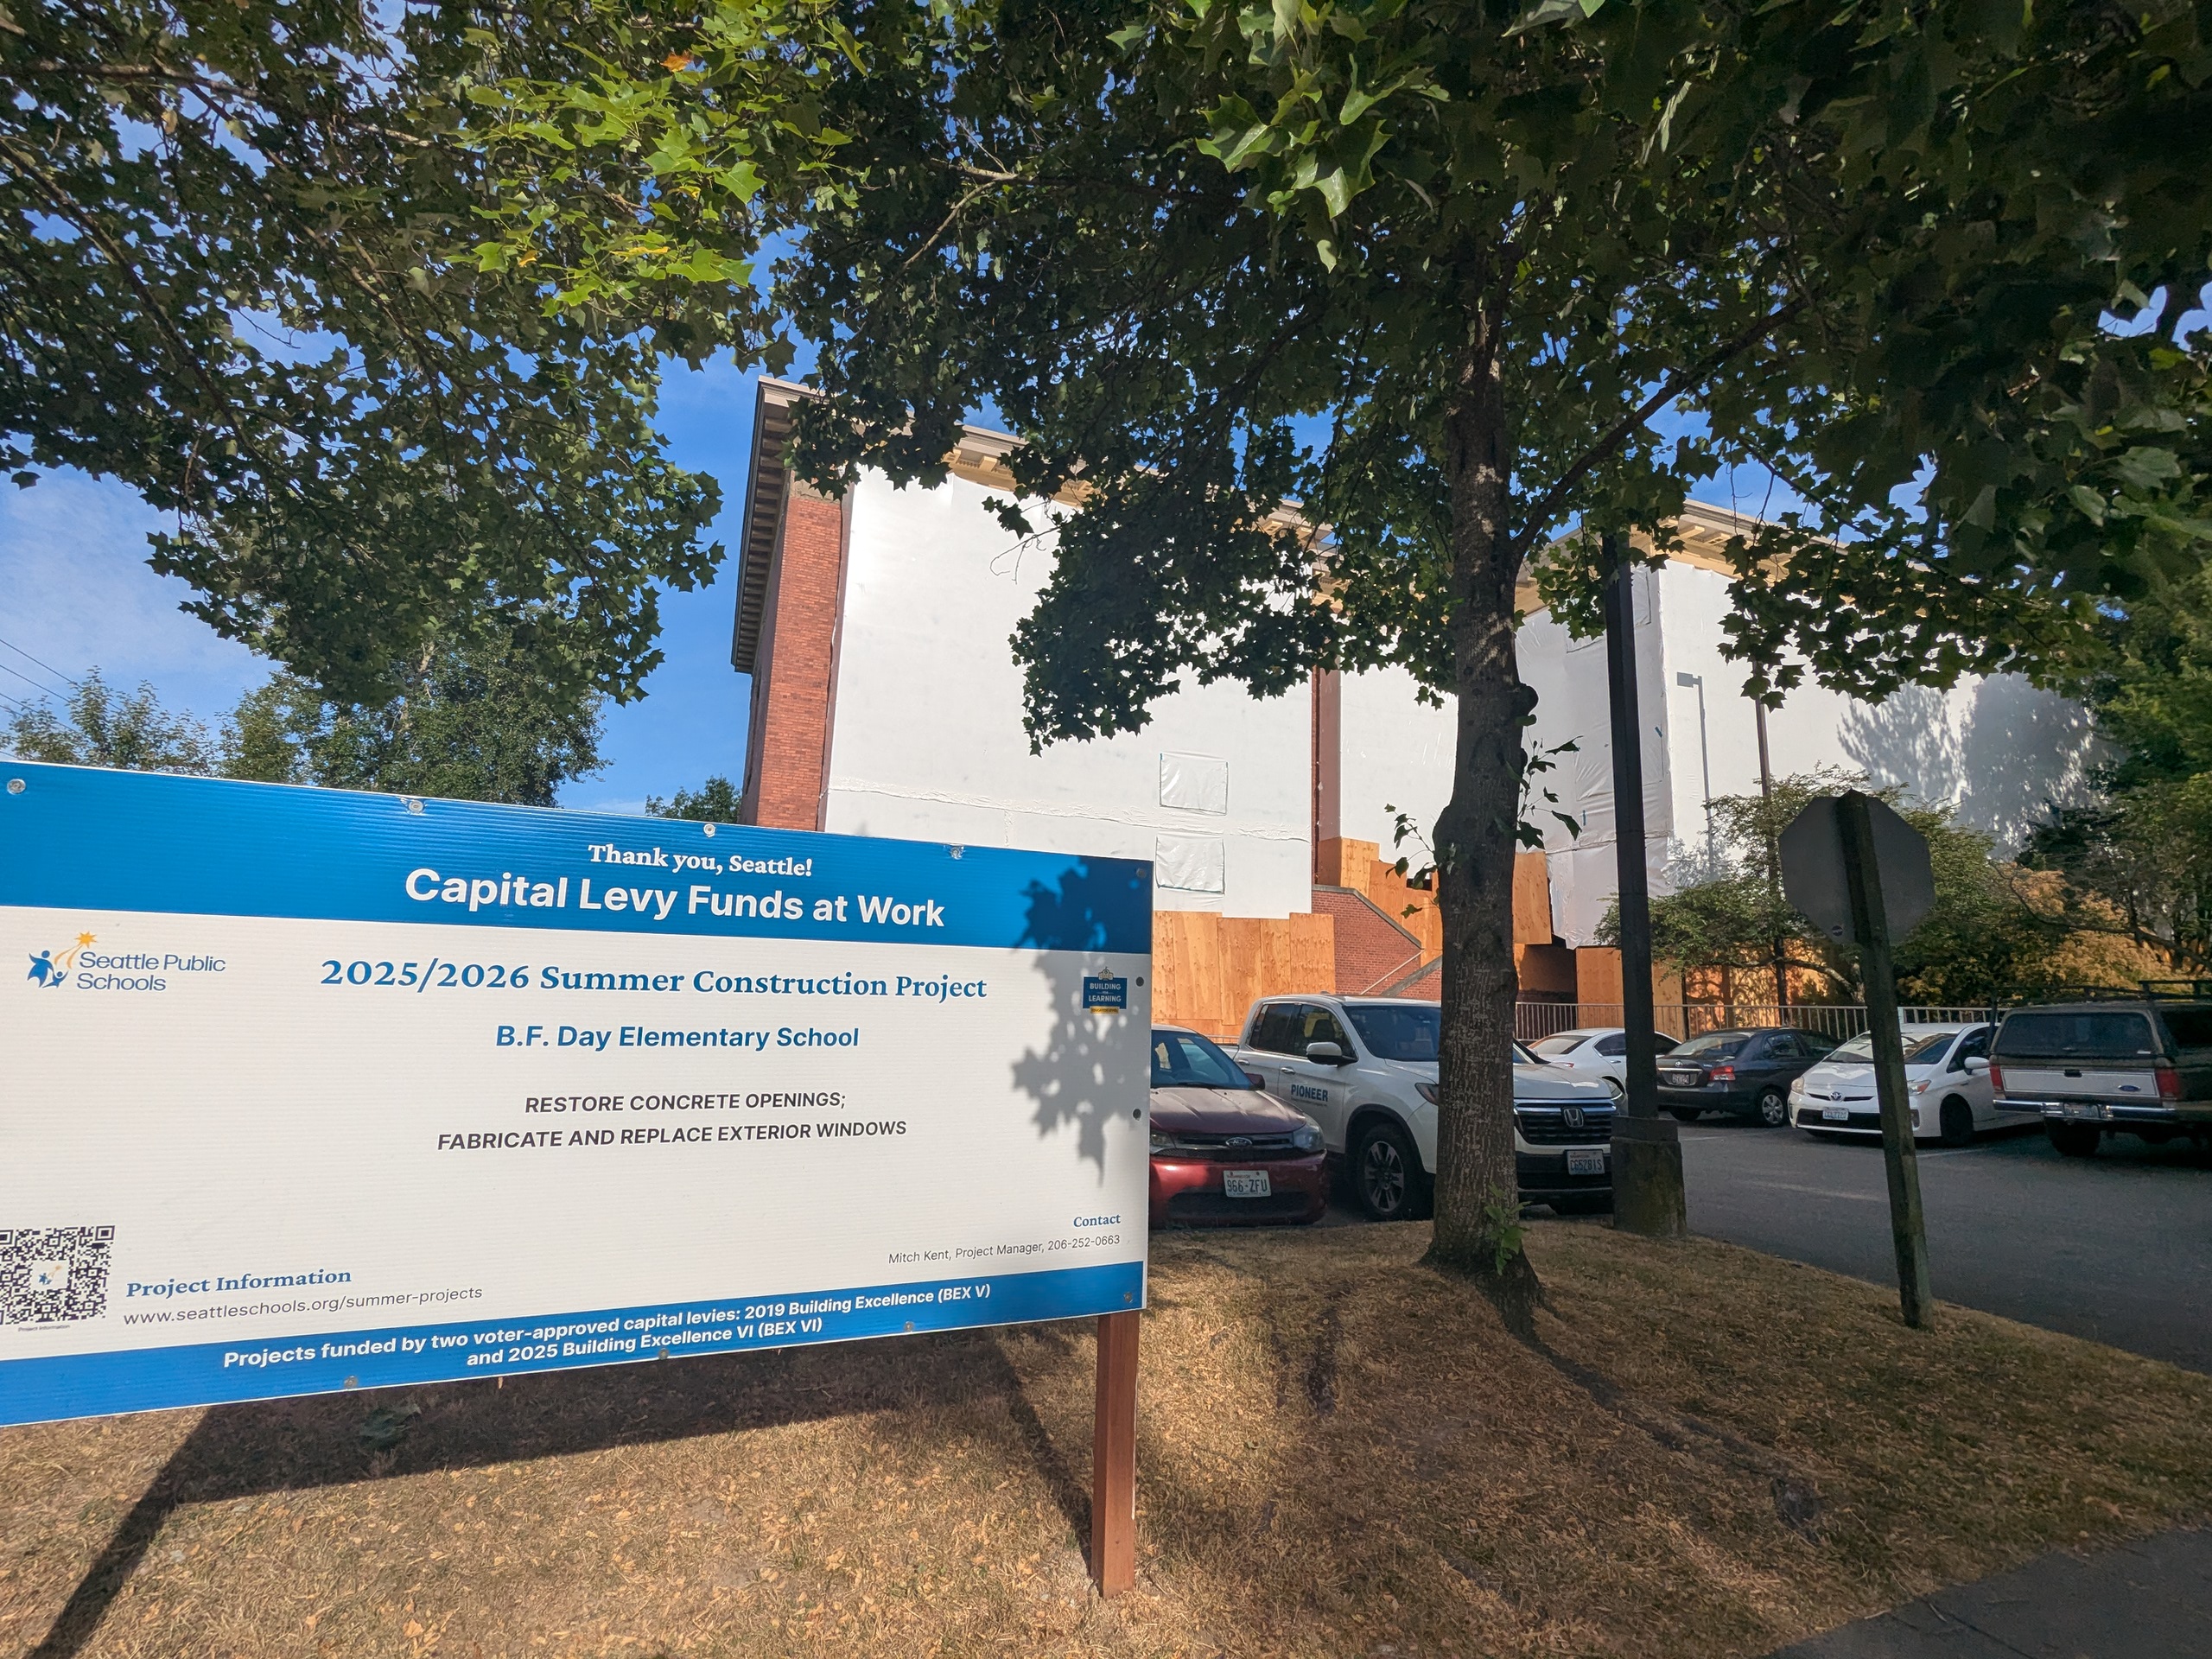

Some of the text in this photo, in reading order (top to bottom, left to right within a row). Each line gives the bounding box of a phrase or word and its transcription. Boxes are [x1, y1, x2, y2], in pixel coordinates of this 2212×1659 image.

[588, 843, 812, 877] Thank you, Seattle!
[405, 868, 945, 927] Capital Levy Funds at Work
[79, 951, 226, 972] Seattle Public
[76, 972, 167, 991] Schools
[321, 957, 988, 1004] 2025/2026 Summer Construction Project
[496, 1025, 859, 1052] B.F. Day Elementary School
[524, 1091, 846, 1113] RESTORE CONCRETE OPENINGS;
[1291, 1084, 1329, 1102] PIONEER
[437, 1121, 906, 1150] FABRICATE AND REPLACE EXTERIOR WINDOWS
[1227, 1179, 1268, 1192] 966-ZFU
[1073, 1214, 1122, 1228] Contact
[888, 1234, 1121, 1264] Mitch Kent, Project Manager, 206-252-0663
[125, 1268, 352, 1300] Project Information
[124, 1286, 484, 1325] www.seattleschools.org/summer-projects
[224, 1283, 991, 1368] Projects funded by two voter-approved capital levies: 2019 Building Excellence (BEX V)
[467, 1317, 823, 1366] and 2025 Building Excellence VI (BEX VI)
